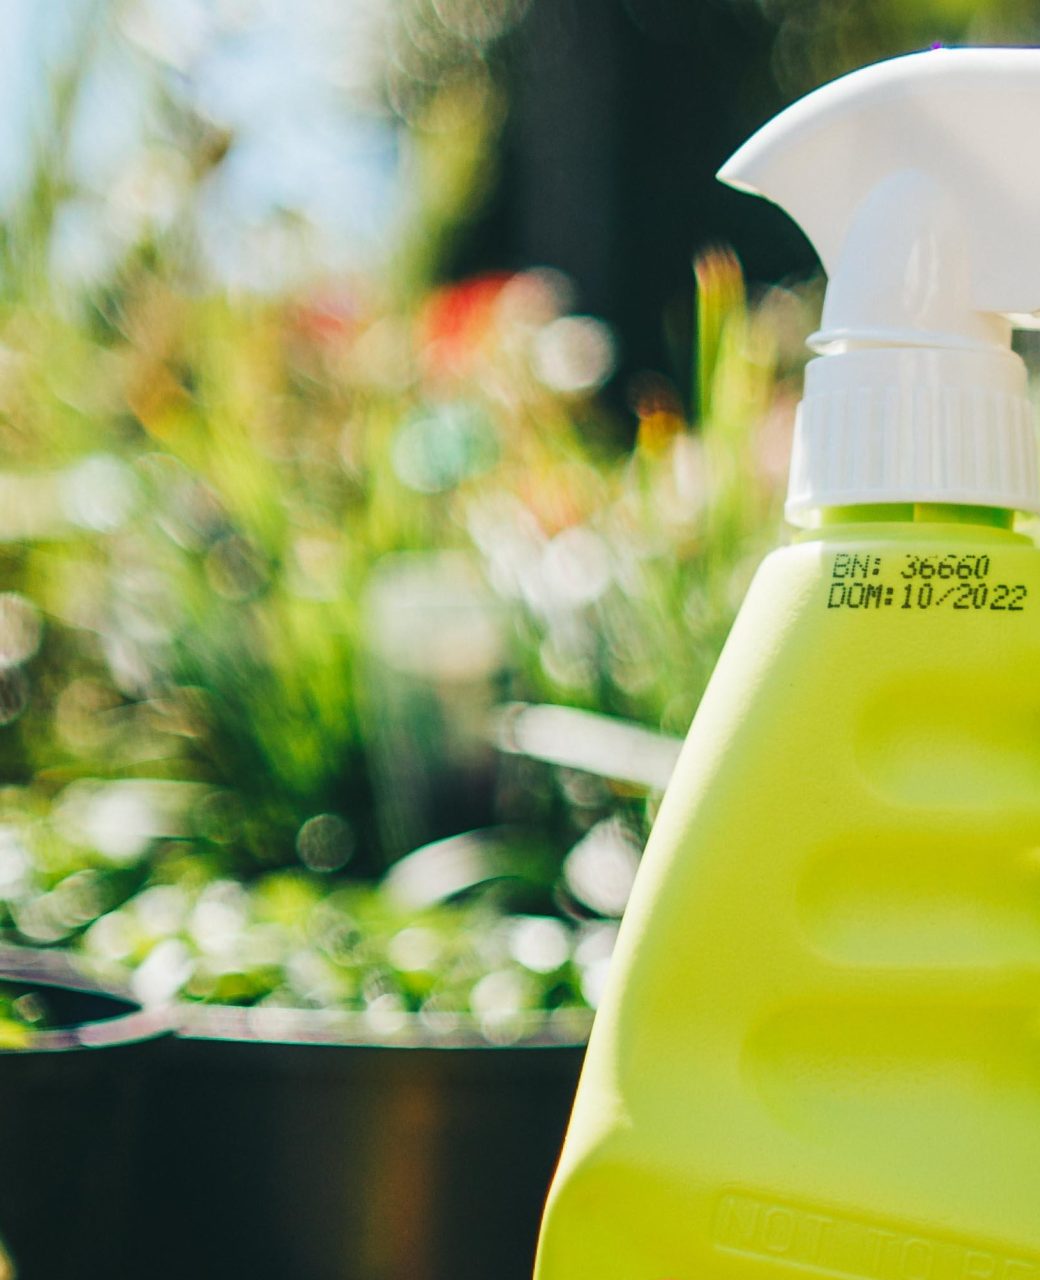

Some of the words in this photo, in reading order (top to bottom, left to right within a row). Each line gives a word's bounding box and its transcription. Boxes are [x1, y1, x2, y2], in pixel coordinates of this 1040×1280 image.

[832, 553, 881, 578] BN:
[900, 554, 990, 579] 36660
[723, 1196, 833, 1260] NOT
